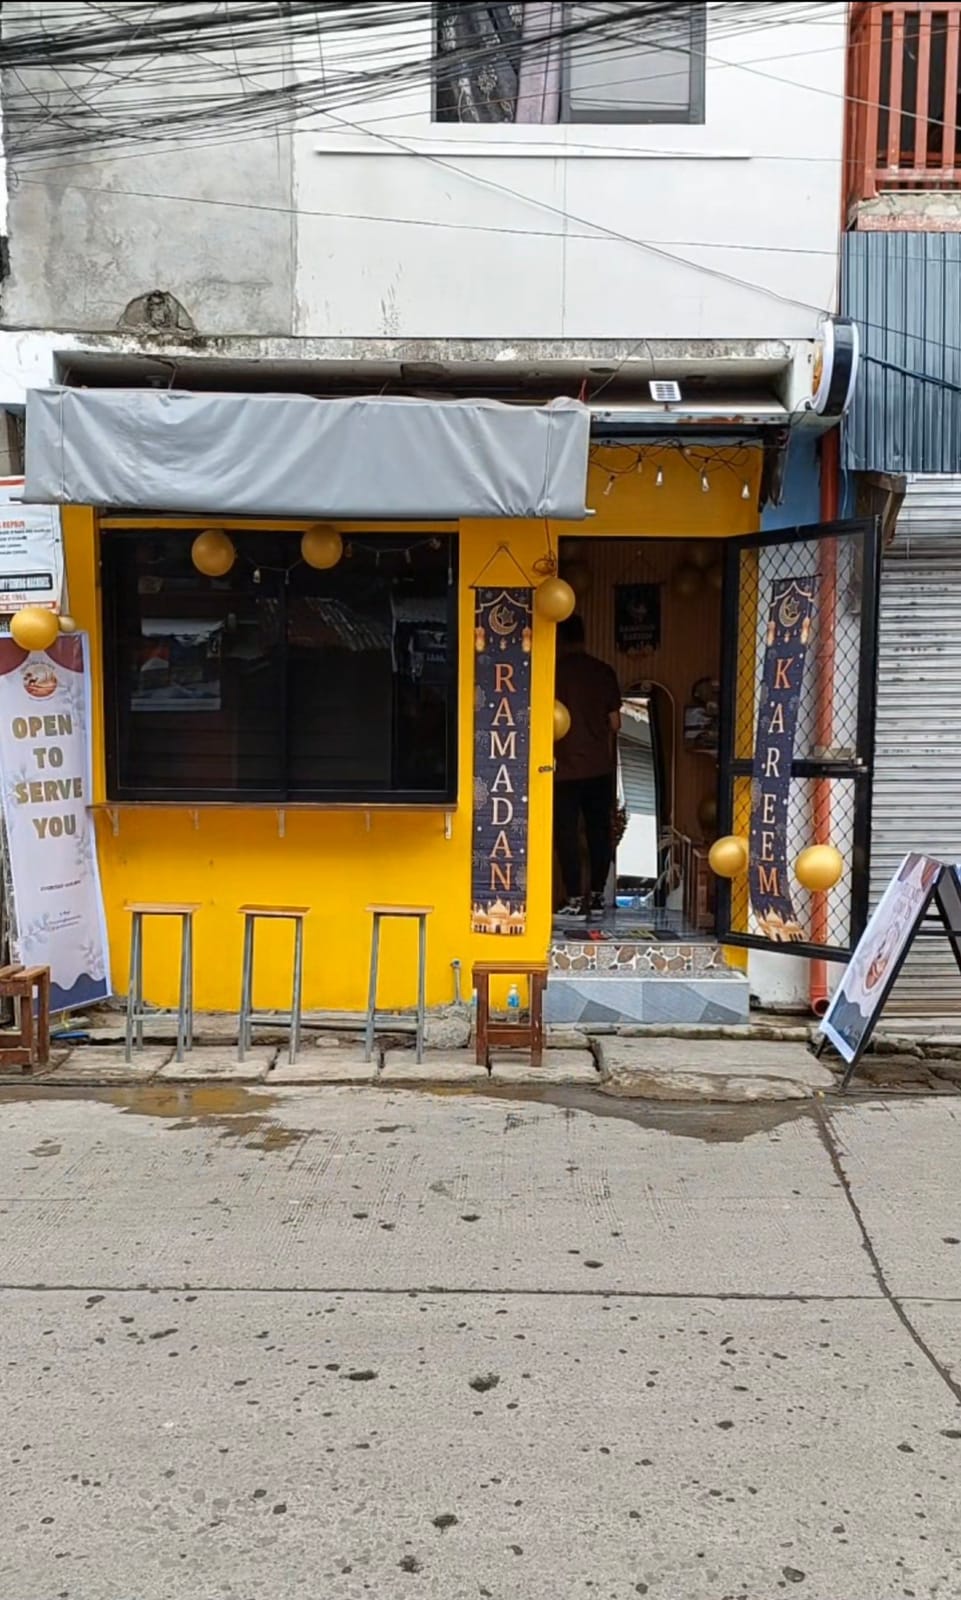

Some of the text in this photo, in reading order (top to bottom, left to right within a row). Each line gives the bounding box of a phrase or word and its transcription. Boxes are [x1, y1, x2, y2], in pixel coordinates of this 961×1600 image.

[12, 714, 73, 739] OPEN
[33, 746, 64, 768] TO
[488, 663, 517, 891] RAMADAN
[757, 657, 794, 897] KAREEM
[15, 777, 83, 804] SERVE
[32, 814, 76, 839] YOU
